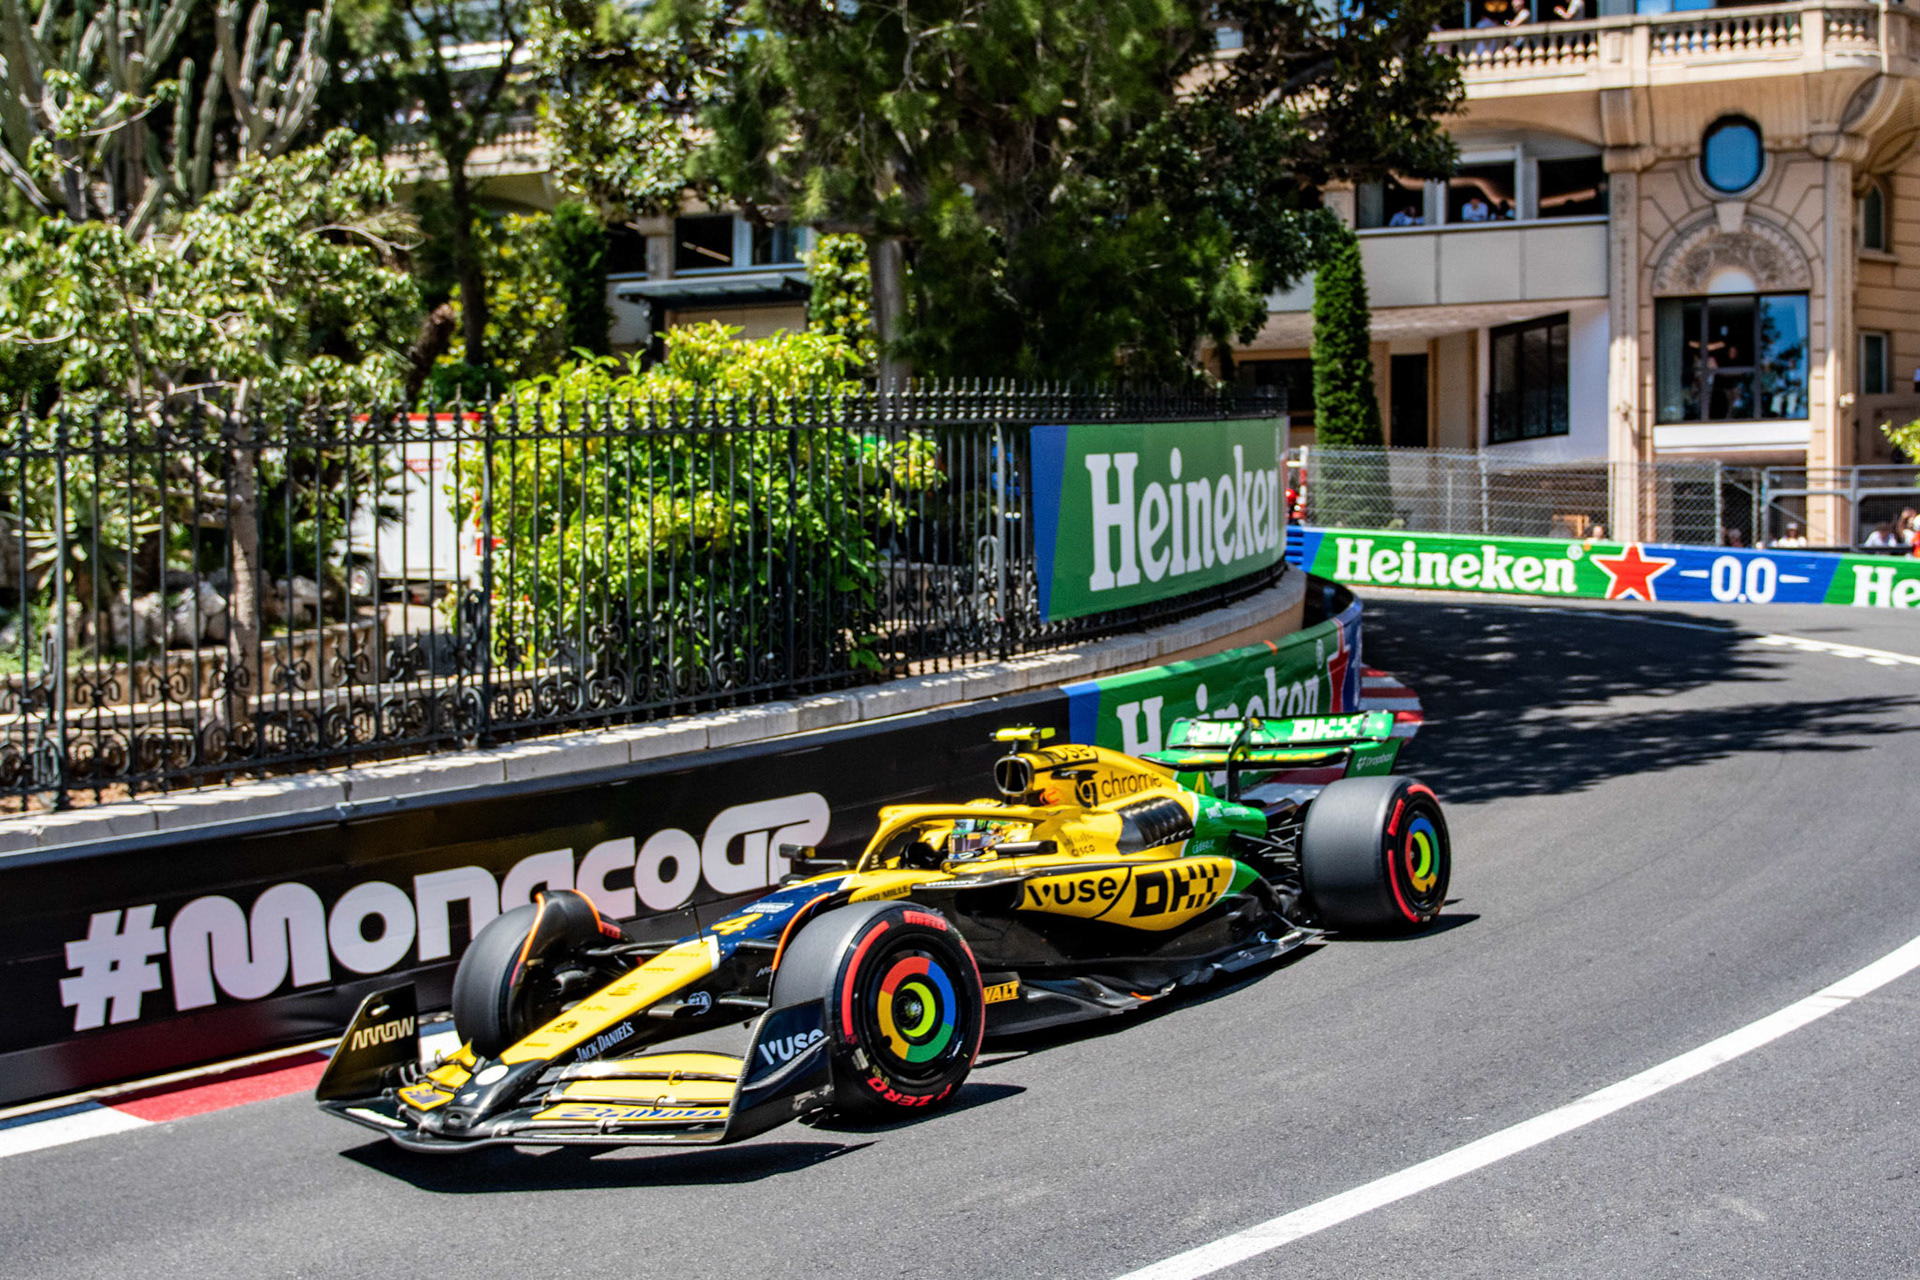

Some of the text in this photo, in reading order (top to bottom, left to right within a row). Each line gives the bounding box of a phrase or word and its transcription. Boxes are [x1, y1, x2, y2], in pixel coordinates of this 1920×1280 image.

[1085, 444, 1279, 592] Heineken
[1333, 537, 1577, 593] Heineken
[1102, 771, 1163, 799] chrome
[710, 912, 763, 936] 4
[352, 1016, 415, 1051] ARROW
[575, 1043, 601, 1063] JACK
[867, 1076, 935, 1107] ZERO
